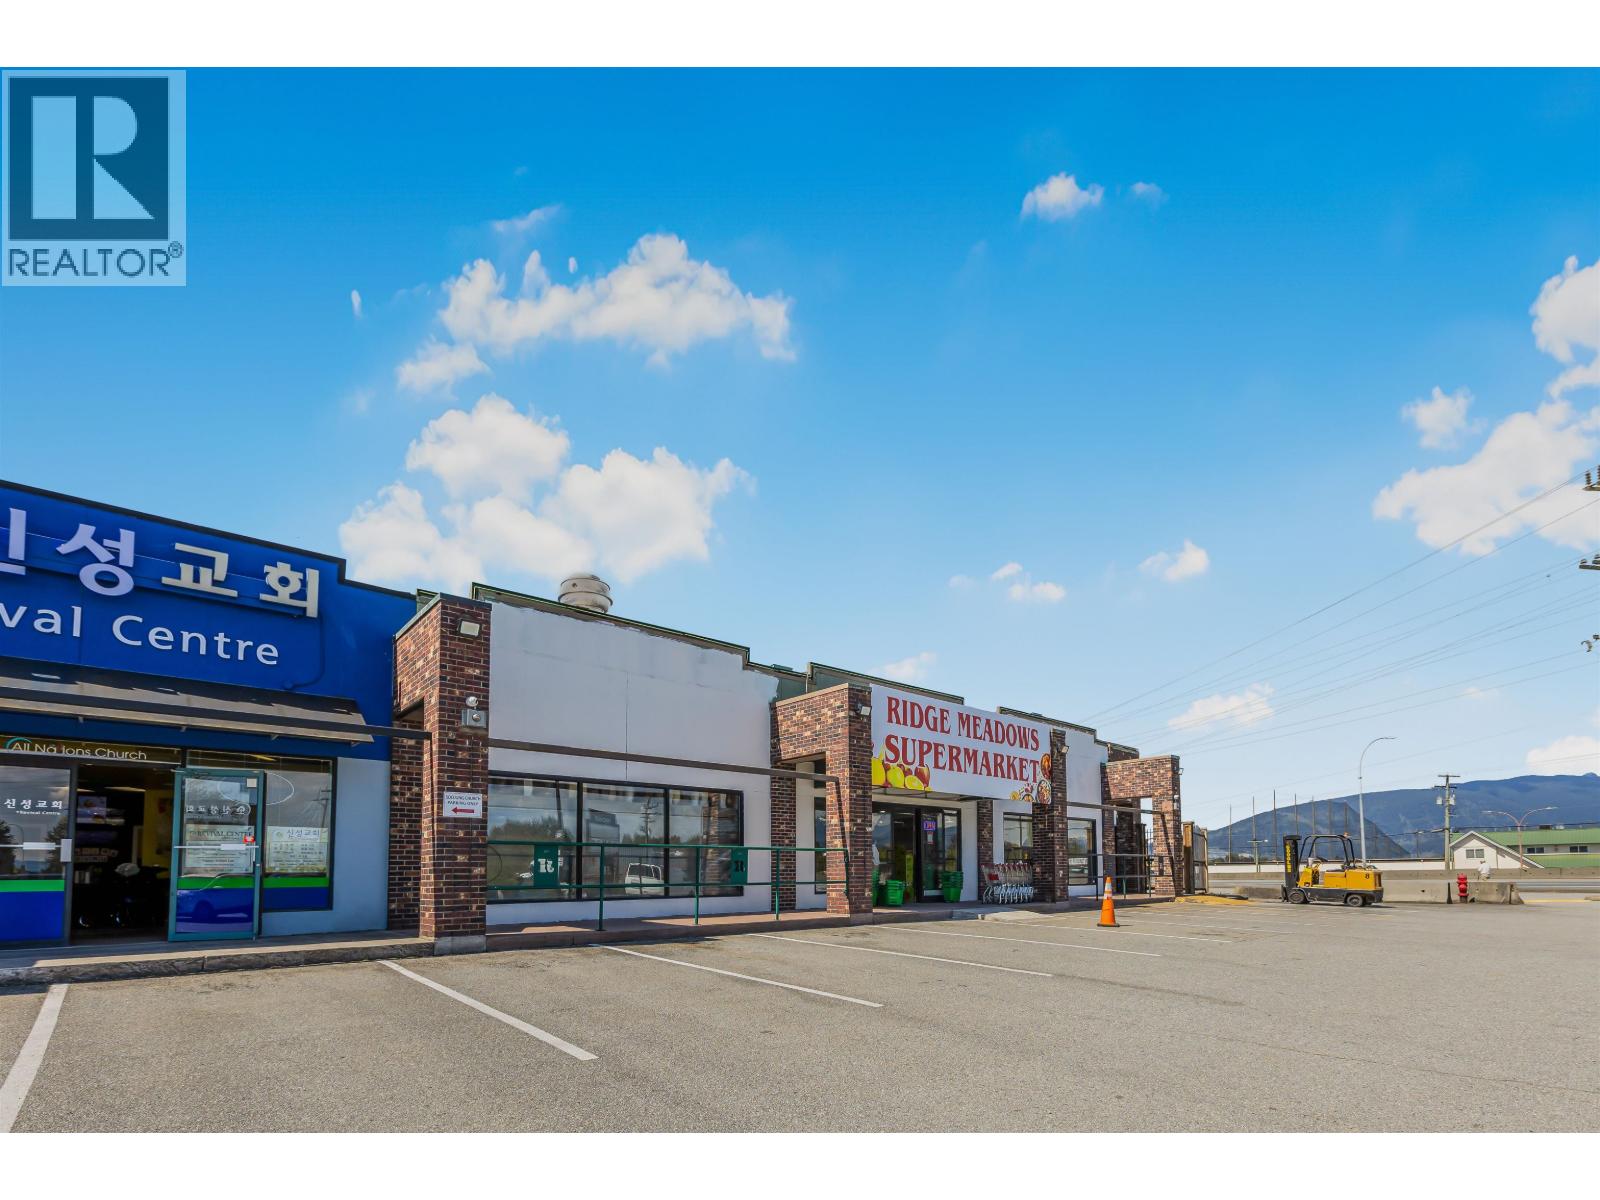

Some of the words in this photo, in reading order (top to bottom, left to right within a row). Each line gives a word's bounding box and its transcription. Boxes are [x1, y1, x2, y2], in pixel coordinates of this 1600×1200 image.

[112, 614, 279, 665] Centre
[887, 695, 951, 735] RIDGE
[957, 711, 1040, 752] MEADOWS
[12, 742, 31, 752] All
[34, 743, 91, 757] Naions
[94, 747, 147, 760] Church
[884, 734, 1040, 784] SUPERMARKET
[4, 798, 63, 810] 신성교회
